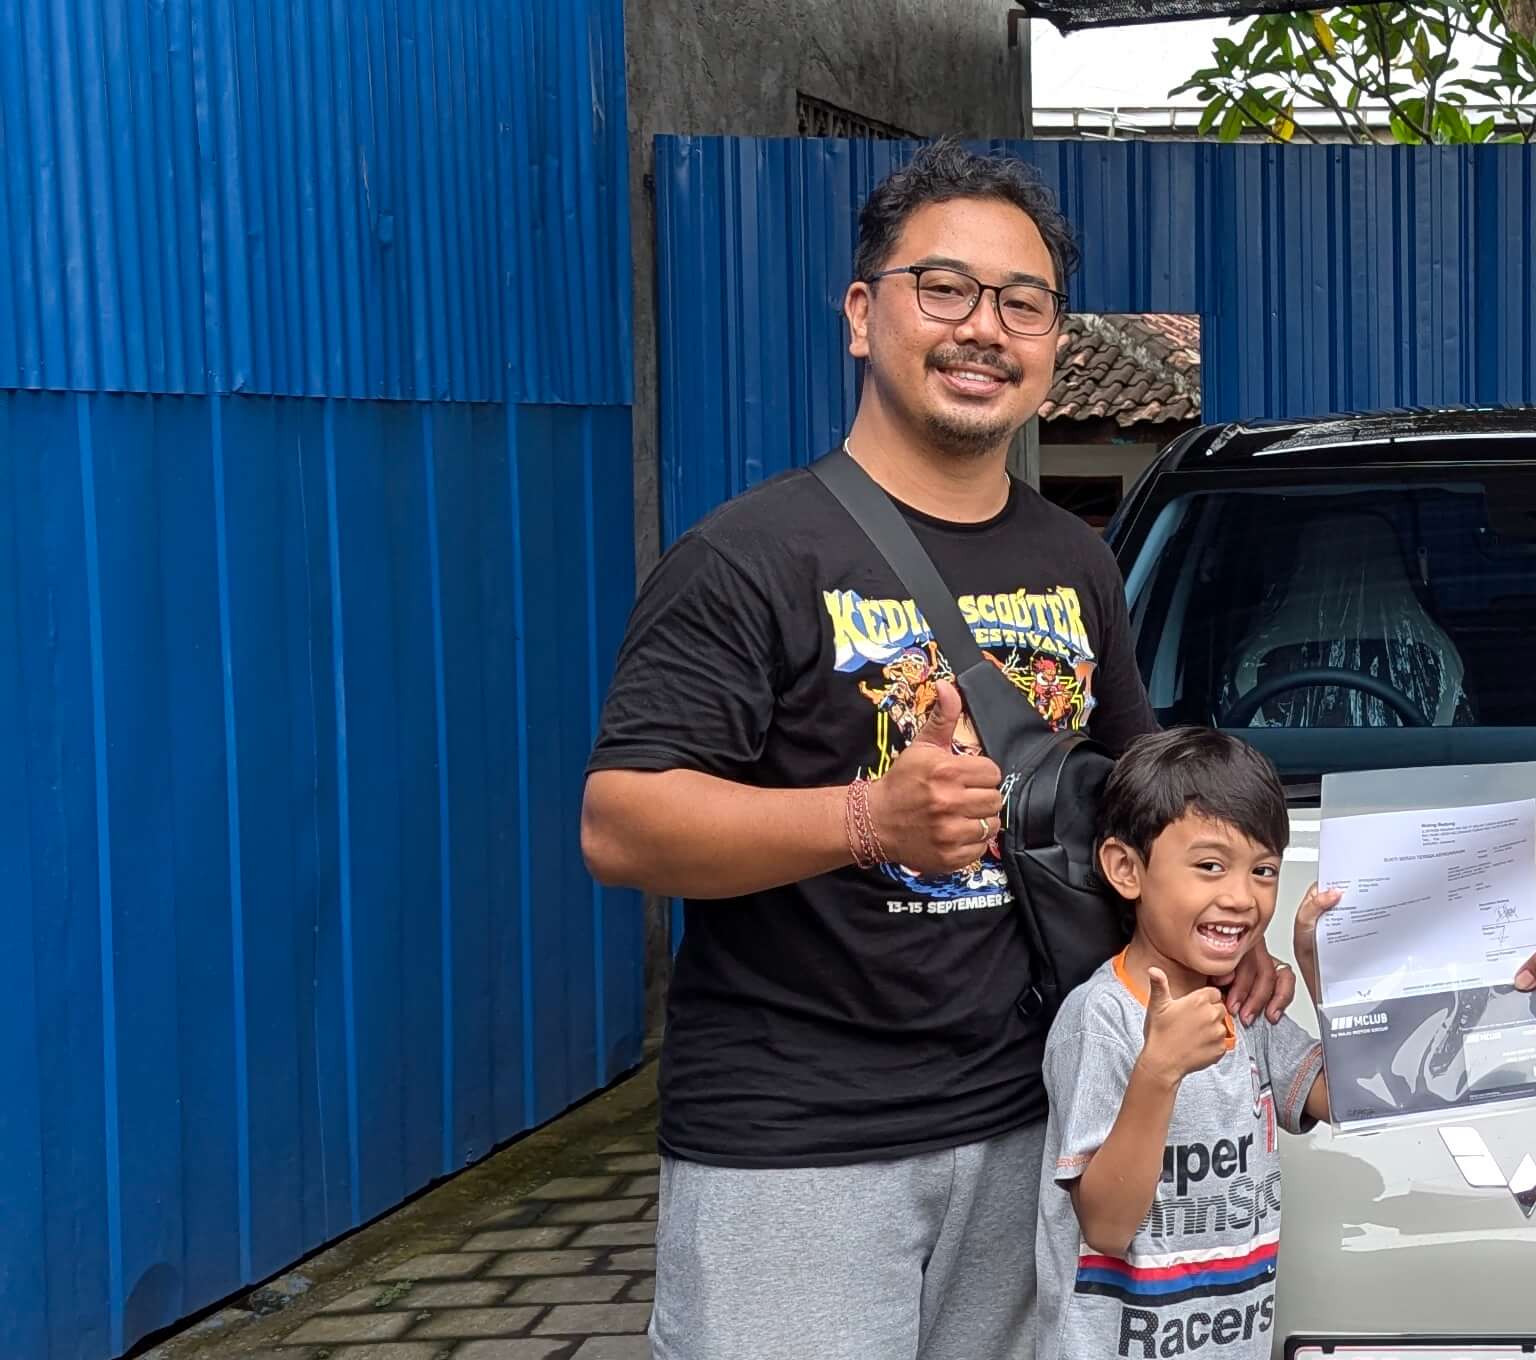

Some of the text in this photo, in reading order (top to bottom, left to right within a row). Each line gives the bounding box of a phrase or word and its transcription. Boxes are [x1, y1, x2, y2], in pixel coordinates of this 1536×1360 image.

[824, 586, 1095, 669] KEDI SCOOTER
[974, 628, 1071, 659] ESTIVAL
[886, 900, 923, 914] 13-15
[926, 894, 1001, 914] SEPTEMBER
[1353, 1011, 1388, 1027] MCLUB
[1118, 1293, 1275, 1360] Racers
